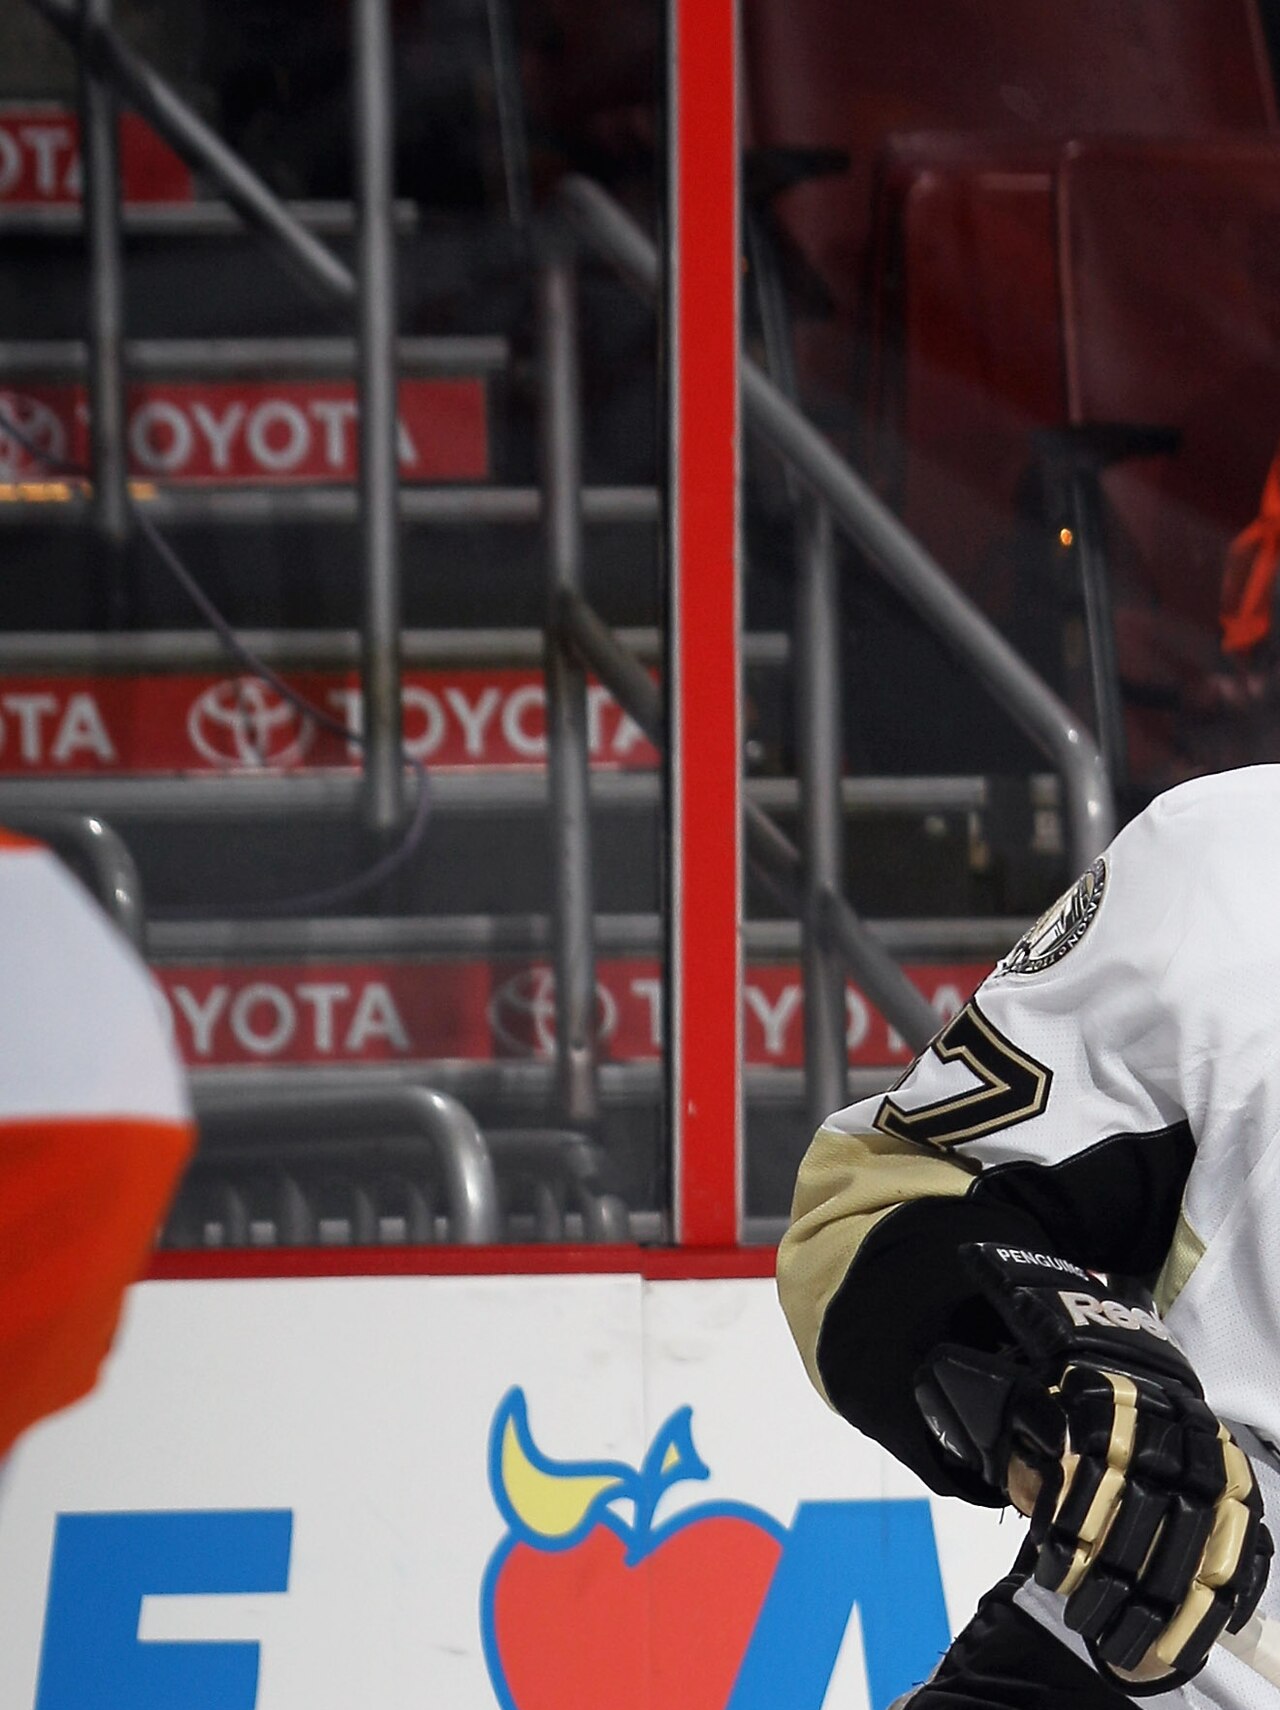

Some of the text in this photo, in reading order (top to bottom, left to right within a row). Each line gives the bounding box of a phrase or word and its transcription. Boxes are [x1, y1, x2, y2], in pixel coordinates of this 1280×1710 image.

[76, 401, 417, 469] OYOT
[0, 690, 115, 763] TA
[172, 981, 410, 1056] YOTA
[1058, 1290, 1172, 1341] Ree
